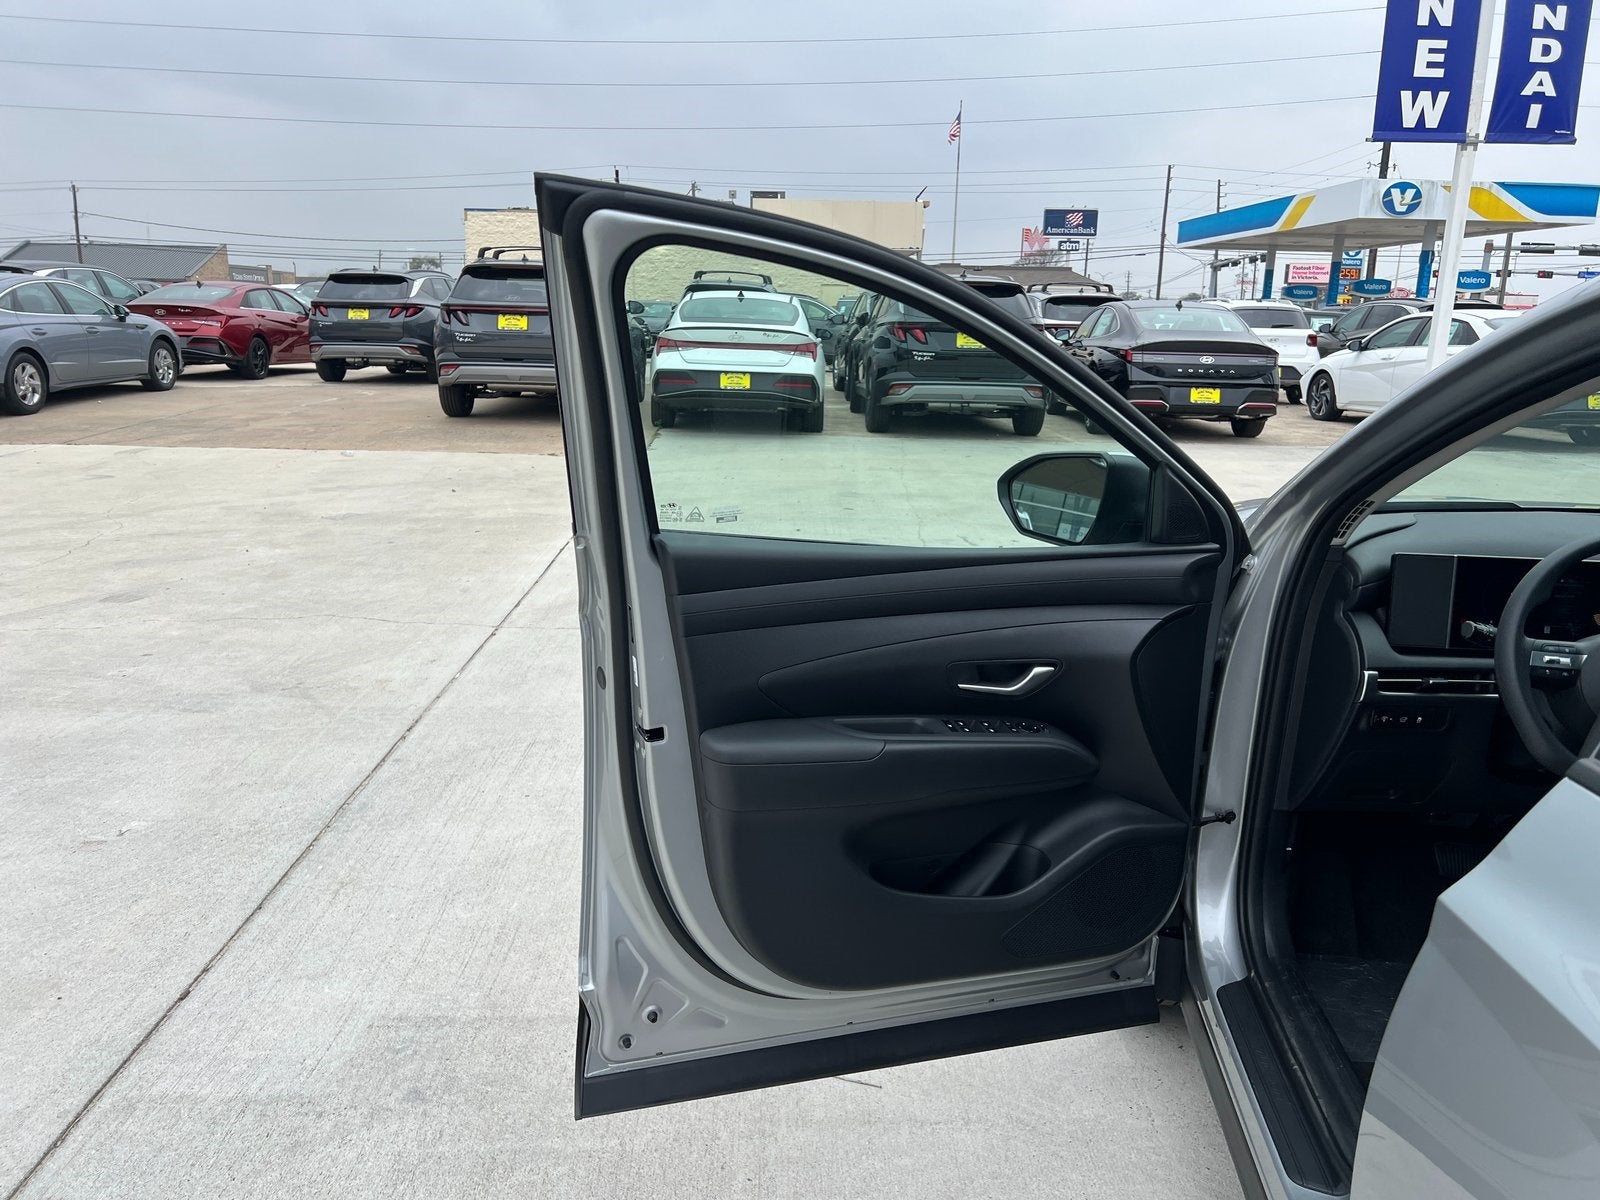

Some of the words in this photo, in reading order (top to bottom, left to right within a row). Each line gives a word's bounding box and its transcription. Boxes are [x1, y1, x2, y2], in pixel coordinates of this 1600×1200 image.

[1400, 0, 1455, 128] NEW
[1060, 242, 1079, 250] atm
[1459, 276, 1486, 284] Valero
